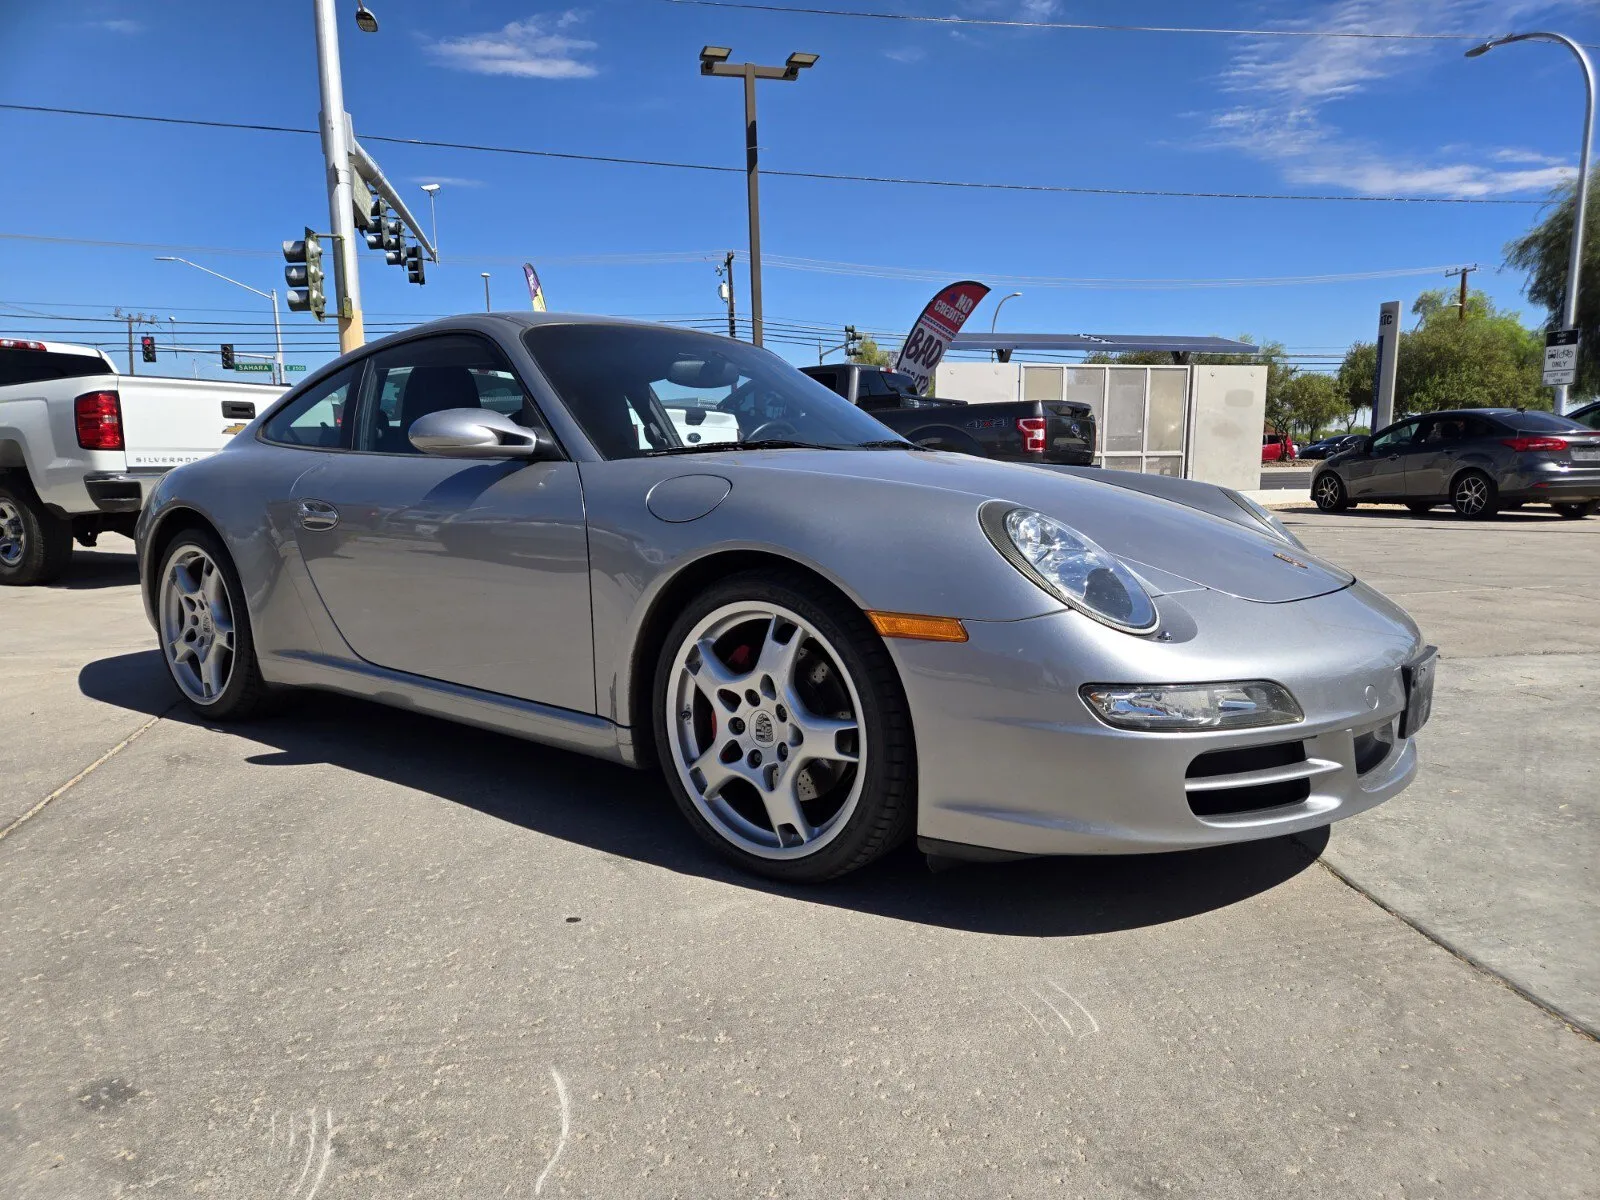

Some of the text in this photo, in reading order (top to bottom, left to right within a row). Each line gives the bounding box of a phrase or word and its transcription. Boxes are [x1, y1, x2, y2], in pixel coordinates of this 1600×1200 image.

[934, 299, 966, 326] CREDIT?
[955, 293, 974, 314] NO
[905, 327, 943, 370] BAD
